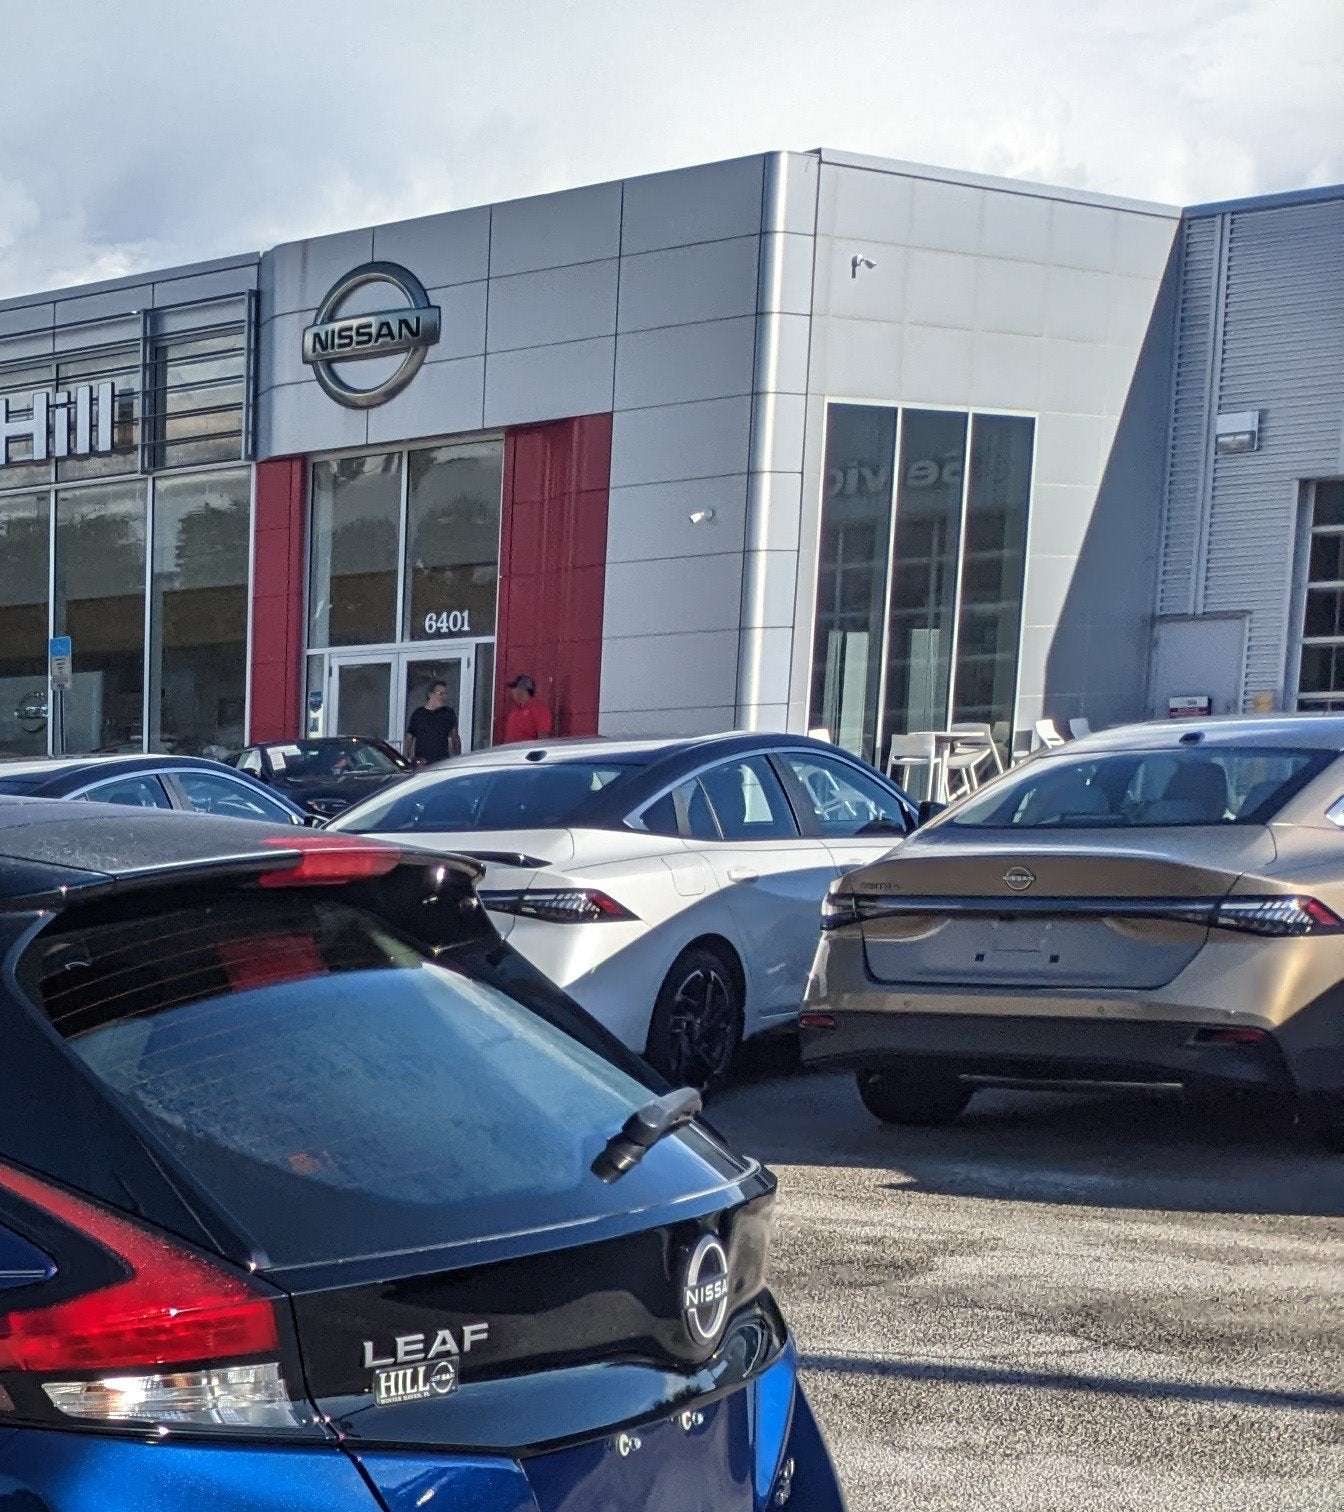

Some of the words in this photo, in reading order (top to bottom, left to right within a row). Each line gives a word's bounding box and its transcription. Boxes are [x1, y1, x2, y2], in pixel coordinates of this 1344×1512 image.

[312, 316, 421, 354] NISSAN
[424, 609, 471, 634] 6401
[685, 1278, 728, 1307] NISSA
[363, 1322, 489, 1368] LEAF
[379, 1366, 430, 1398] HILL
